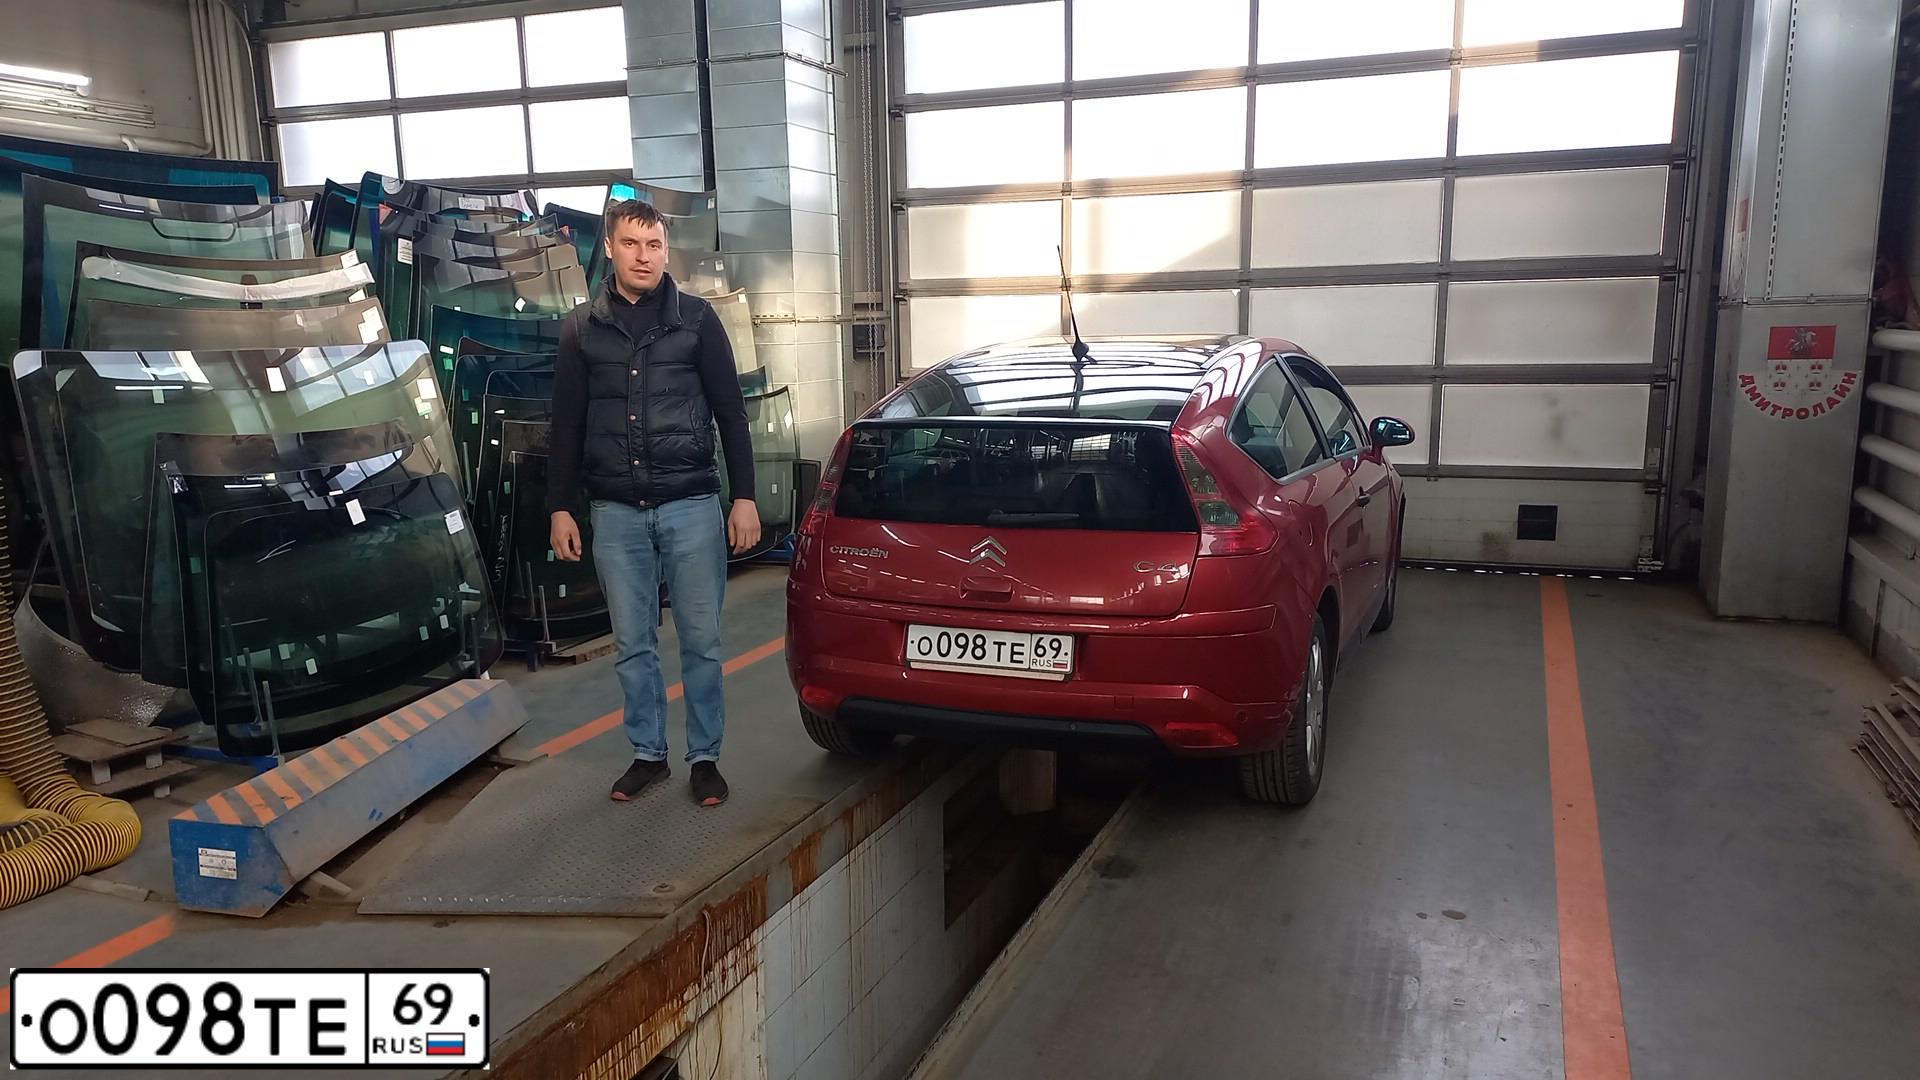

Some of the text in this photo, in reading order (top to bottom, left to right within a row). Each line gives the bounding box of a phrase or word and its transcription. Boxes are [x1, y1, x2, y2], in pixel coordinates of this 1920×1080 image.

[1739, 372, 1857, 420] ДМИТРОЛАЙН
[830, 546, 889, 559] CITROËN
[1034, 637, 1062, 659] 69
[1031, 659, 1052, 668] RUS
